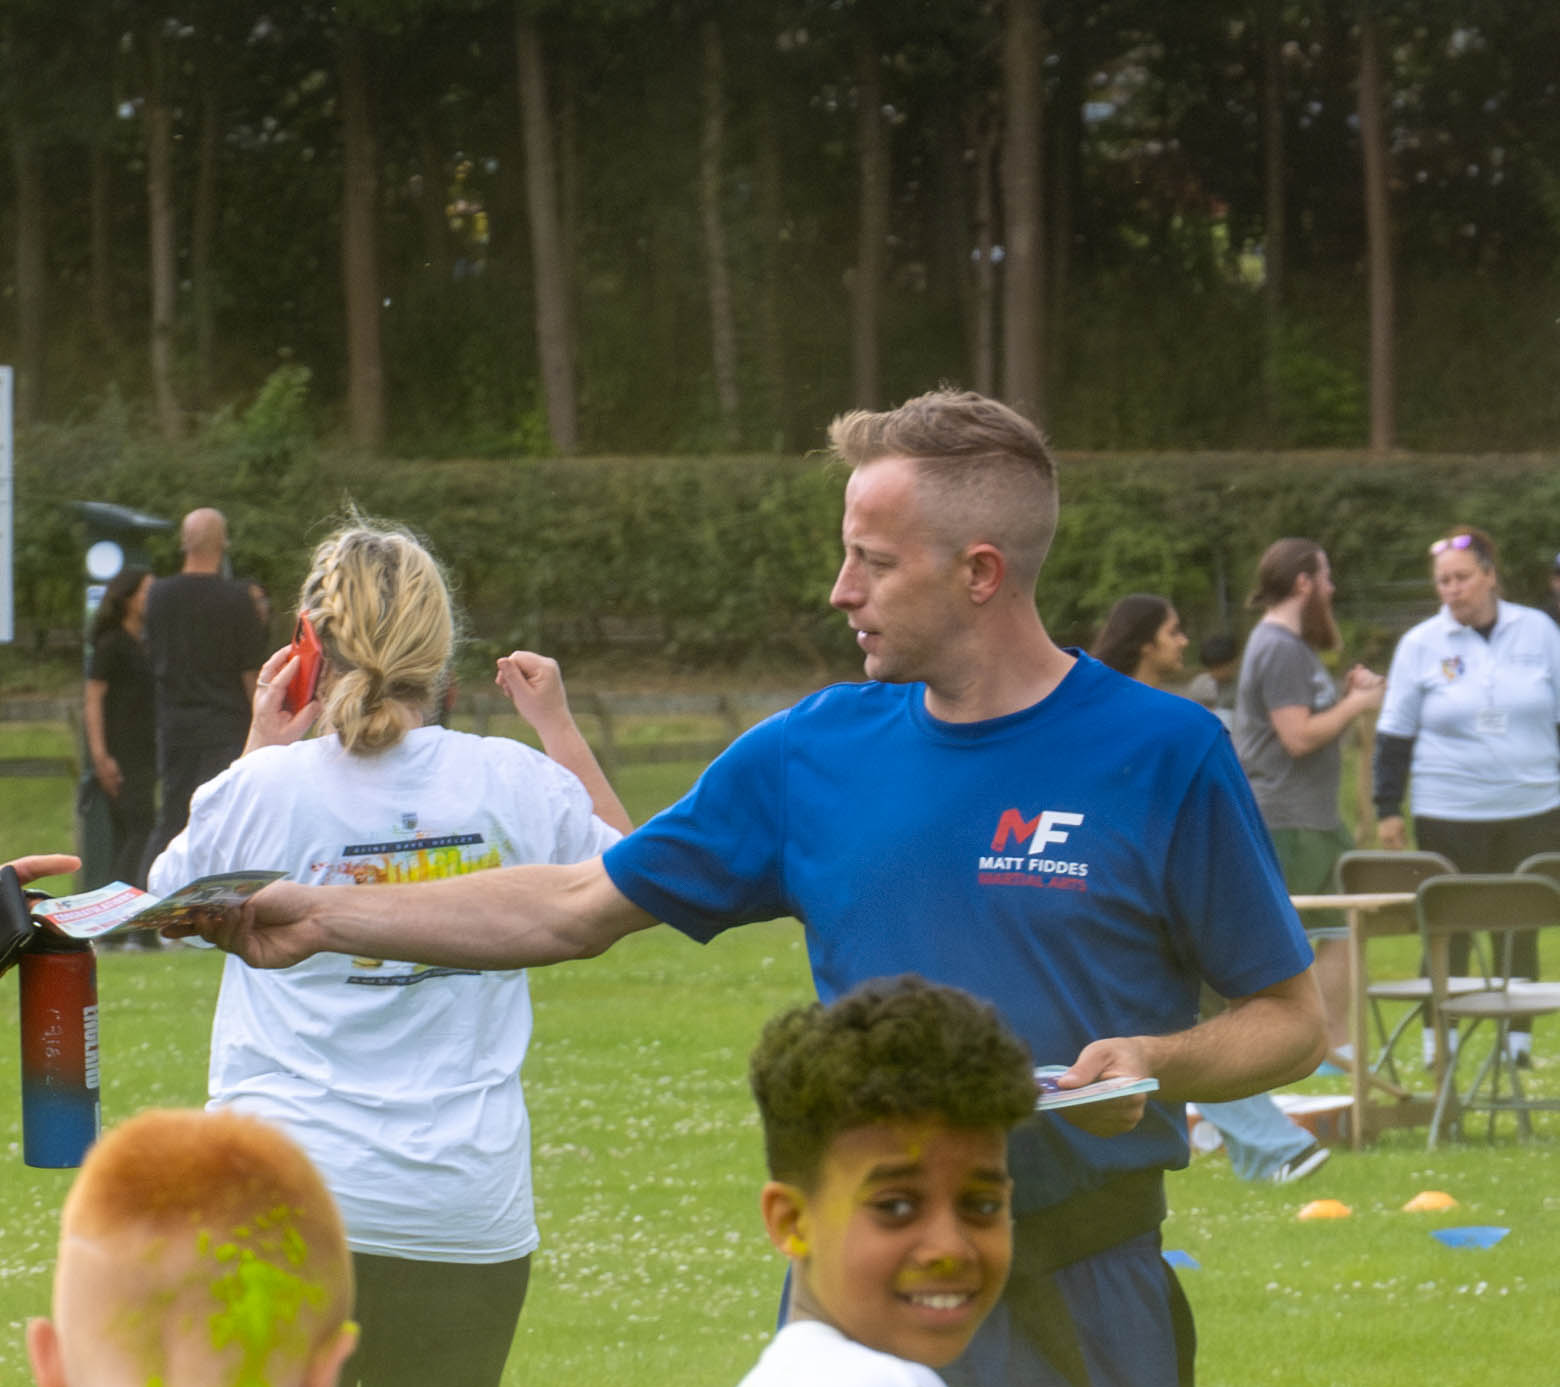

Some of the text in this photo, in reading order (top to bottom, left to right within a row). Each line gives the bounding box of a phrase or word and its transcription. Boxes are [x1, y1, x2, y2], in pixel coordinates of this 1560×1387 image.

[990, 807, 1084, 855] MF
[978, 857, 1088, 876] MATT FIDDES
